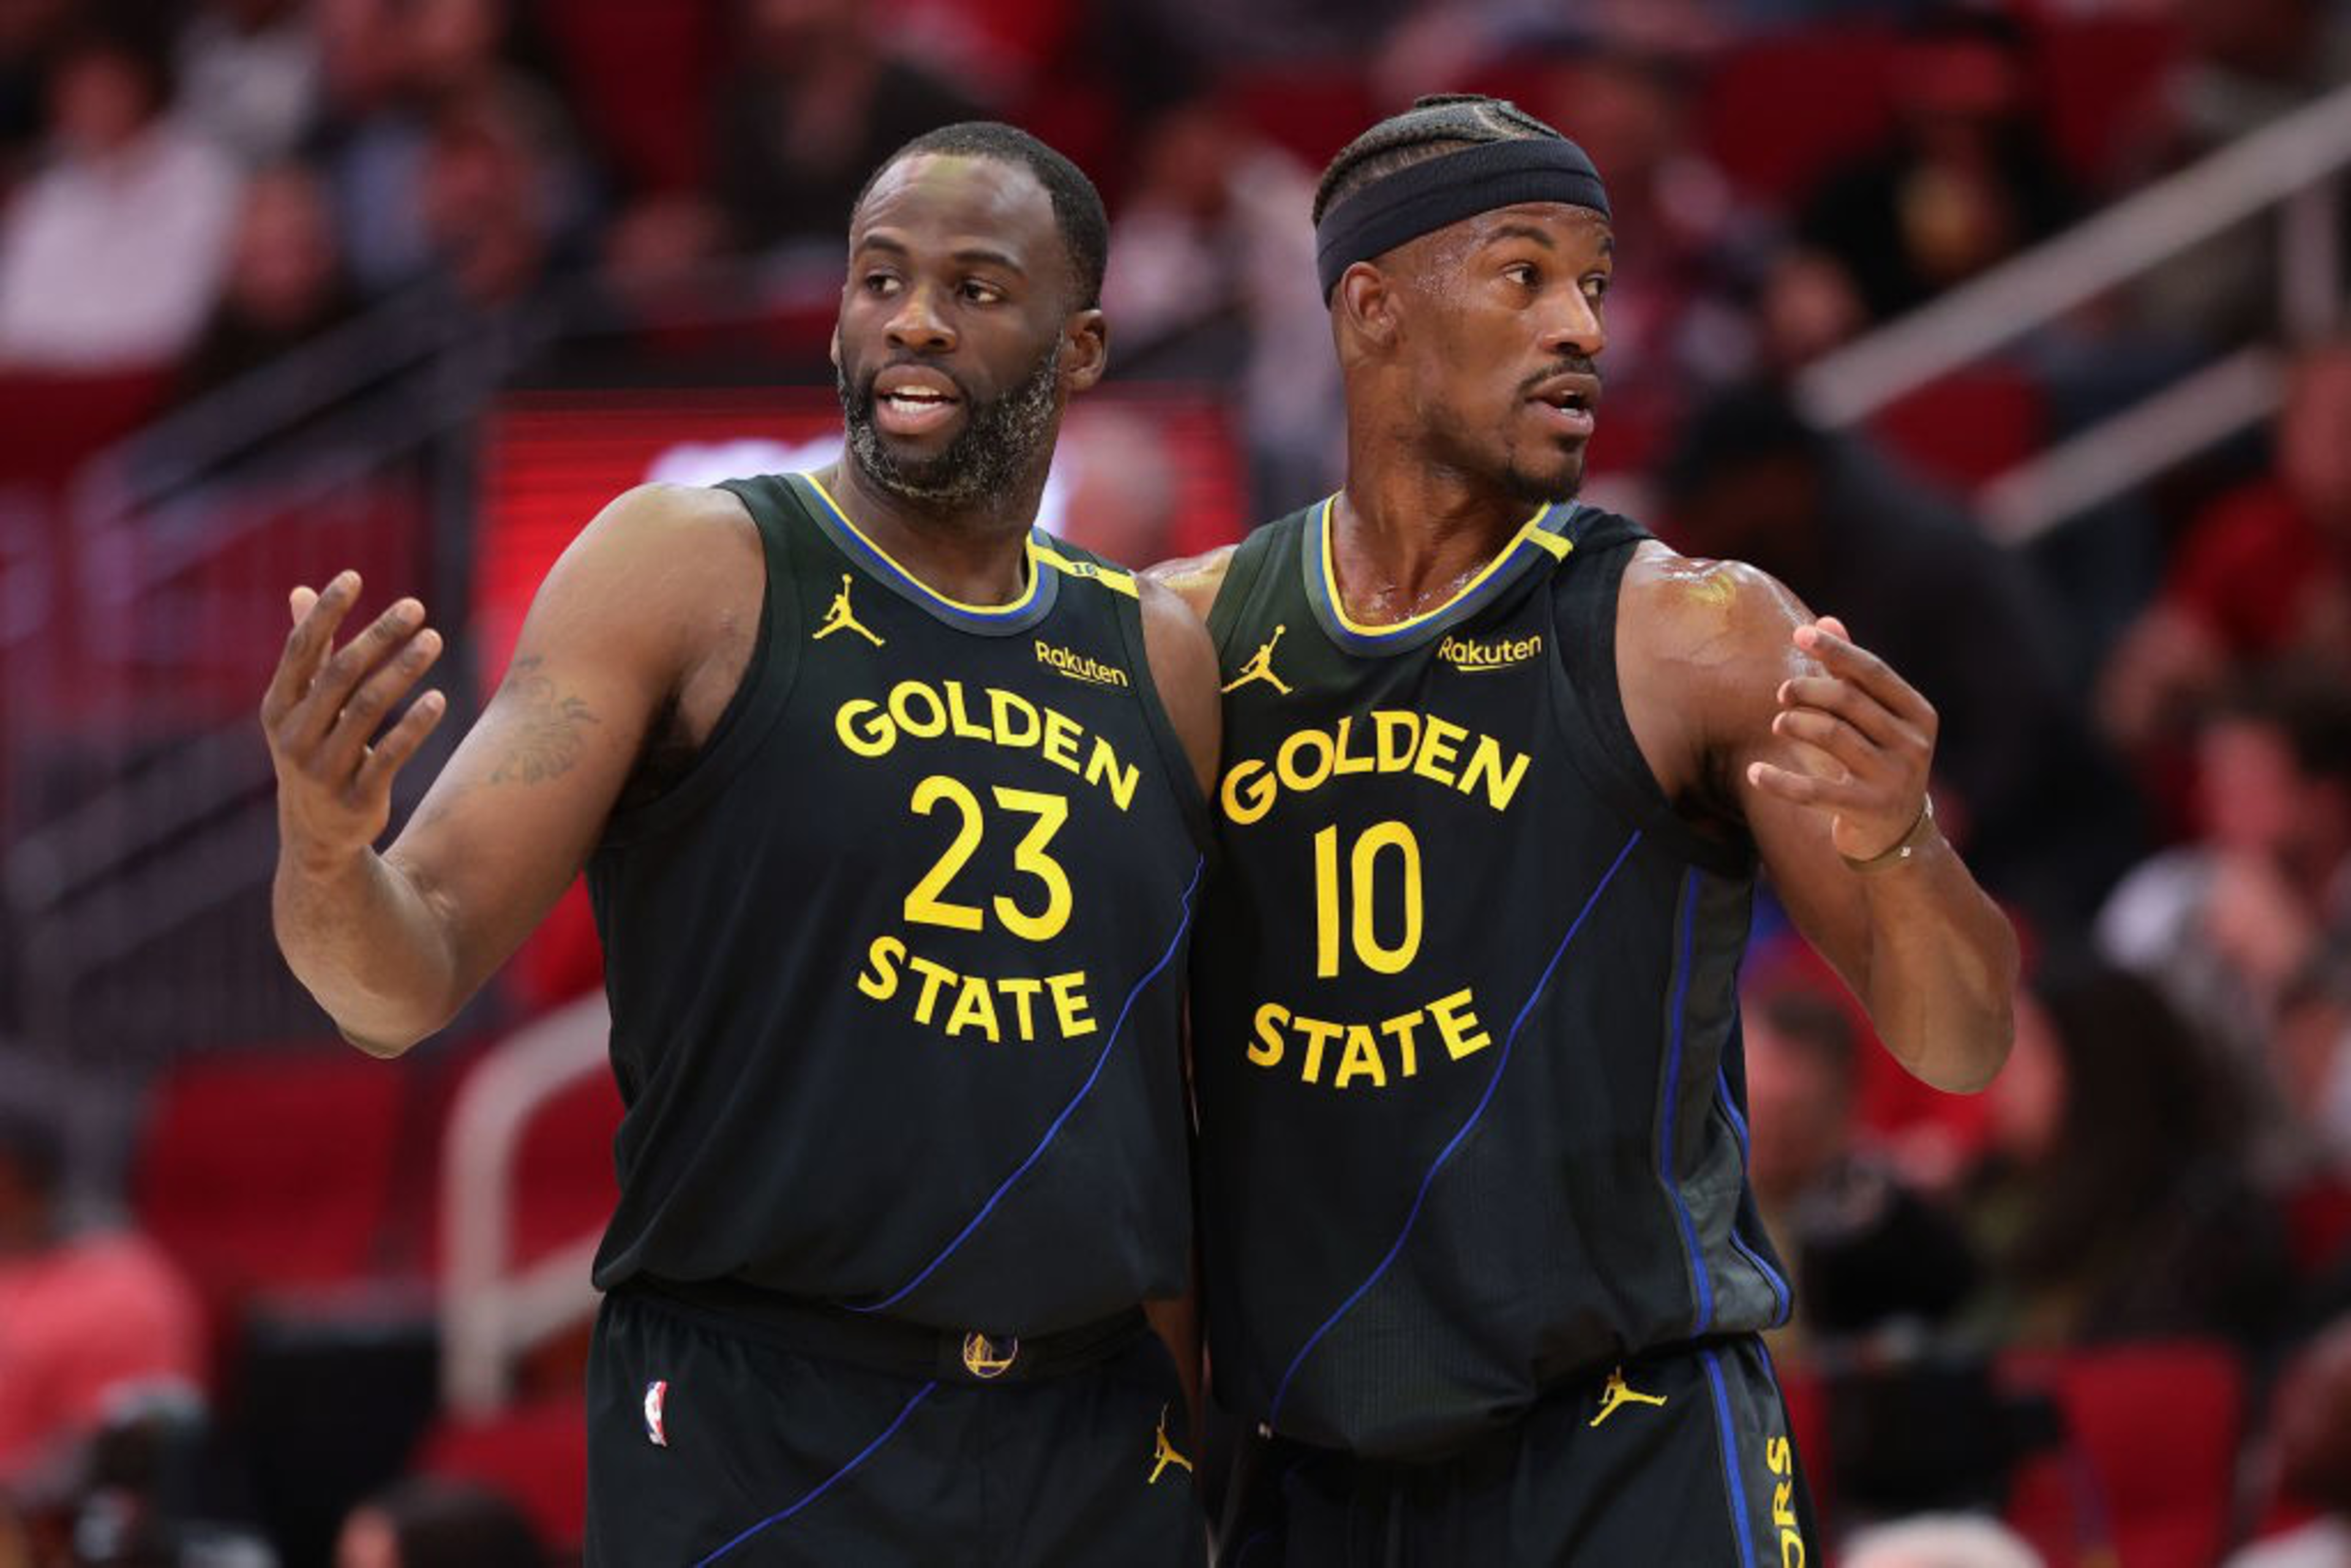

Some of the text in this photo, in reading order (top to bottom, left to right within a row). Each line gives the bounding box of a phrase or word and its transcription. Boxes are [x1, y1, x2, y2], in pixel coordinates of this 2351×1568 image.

[1035, 639, 1128, 687] Rakuten
[1437, 634, 1542, 669] Rakuten
[834, 679, 1140, 811] GOLDEN
[1220, 709, 1531, 825] GOLDEN
[903, 775, 1074, 943] 23
[1313, 820, 1424, 980] 10
[857, 936, 1098, 1043] STATE
[1247, 987, 1493, 1089] STATE
